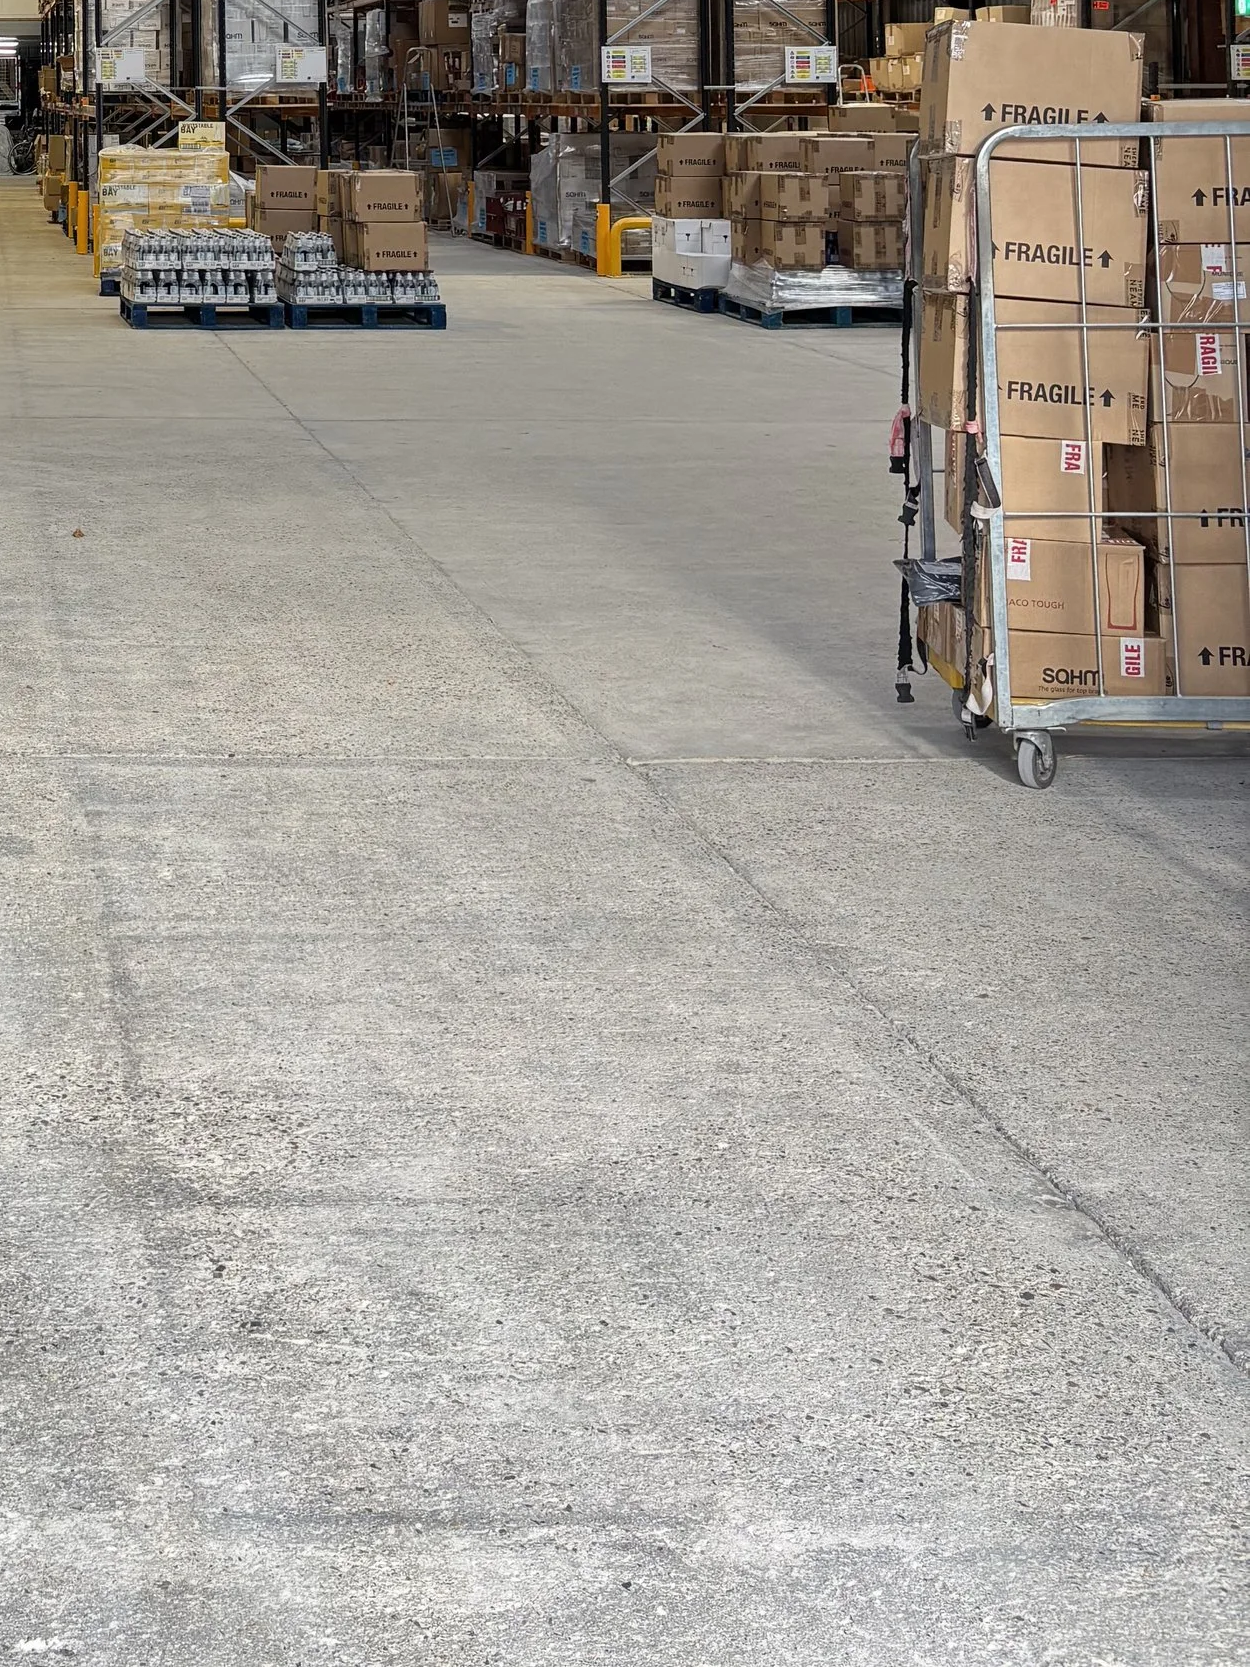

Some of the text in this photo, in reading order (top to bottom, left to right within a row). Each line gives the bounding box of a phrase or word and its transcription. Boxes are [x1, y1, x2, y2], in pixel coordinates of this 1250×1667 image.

[1000, 103, 1089, 125] FRAGILE
[684, 158, 712, 166] FRAGILE
[276, 191, 303, 199] FRAGILE
[373, 202, 403, 211] FRAGILE
[682, 200, 710, 208] FRAGILE
[381, 250, 412, 258] FRAGILE
[1004, 241, 1094, 267] FRAGILE
[1007, 380, 1095, 406] FRAGILE
[1065, 443, 1082, 472] FRA
[1032, 599, 1065, 610] TOUGH
[1124, 644, 1141, 676] GILE
